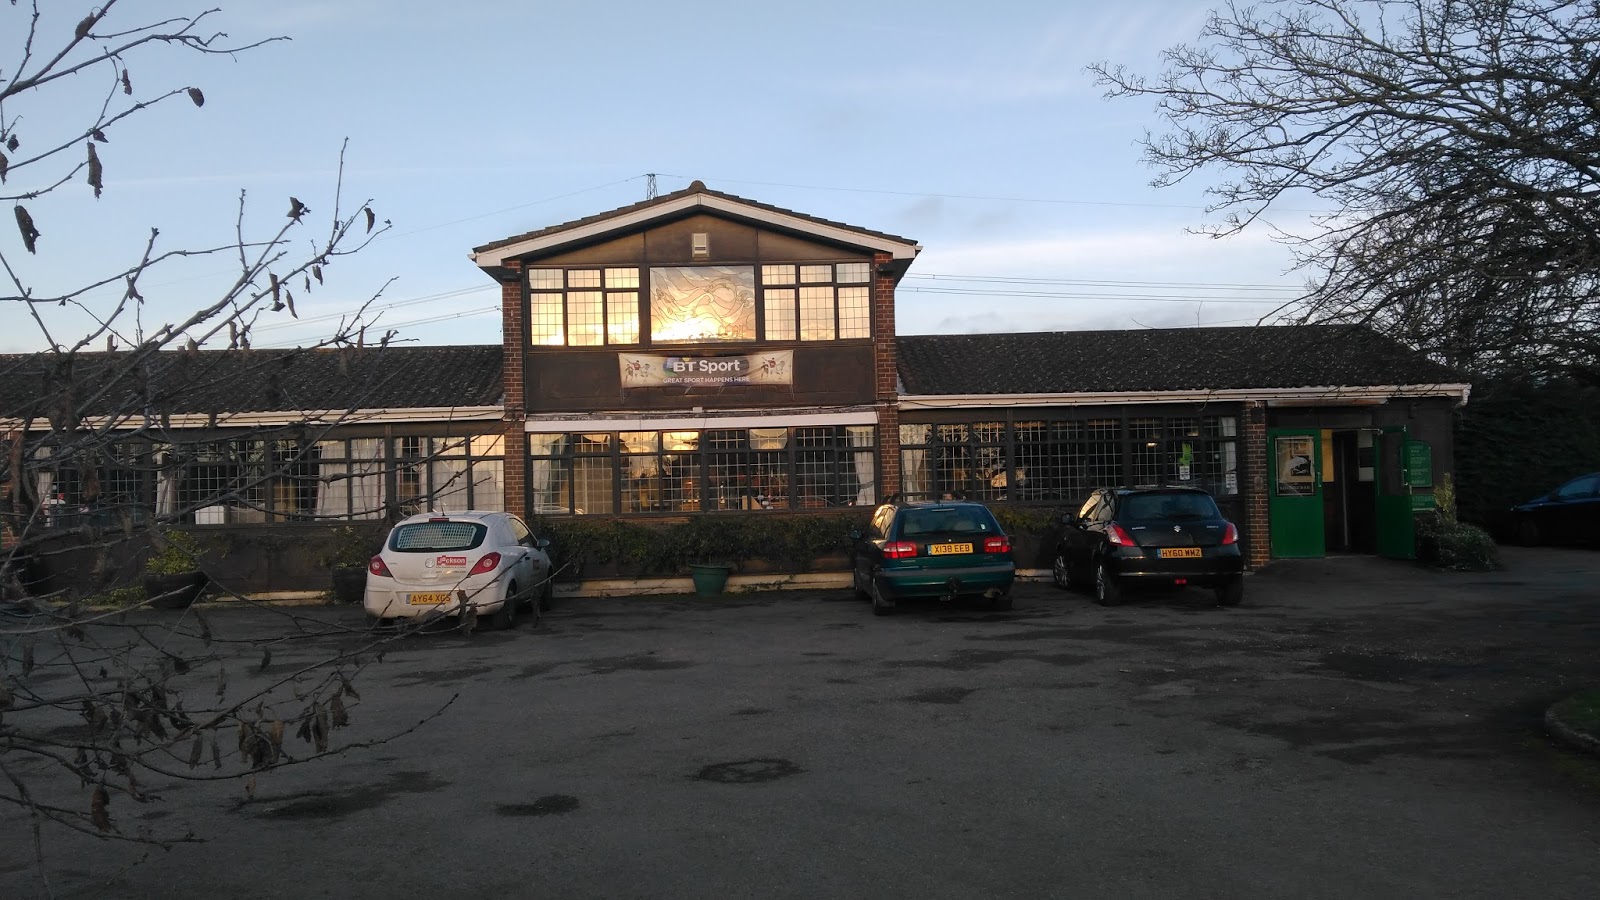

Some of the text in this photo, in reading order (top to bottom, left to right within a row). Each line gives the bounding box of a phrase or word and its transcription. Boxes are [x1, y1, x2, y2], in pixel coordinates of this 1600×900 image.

[673, 360, 741, 374] BT Sport
[934, 544, 970, 553] X138 EEB
[1162, 549, 1183, 557] HY60
[437, 556, 466, 564] Jackson
[412, 594, 433, 602] AY64
